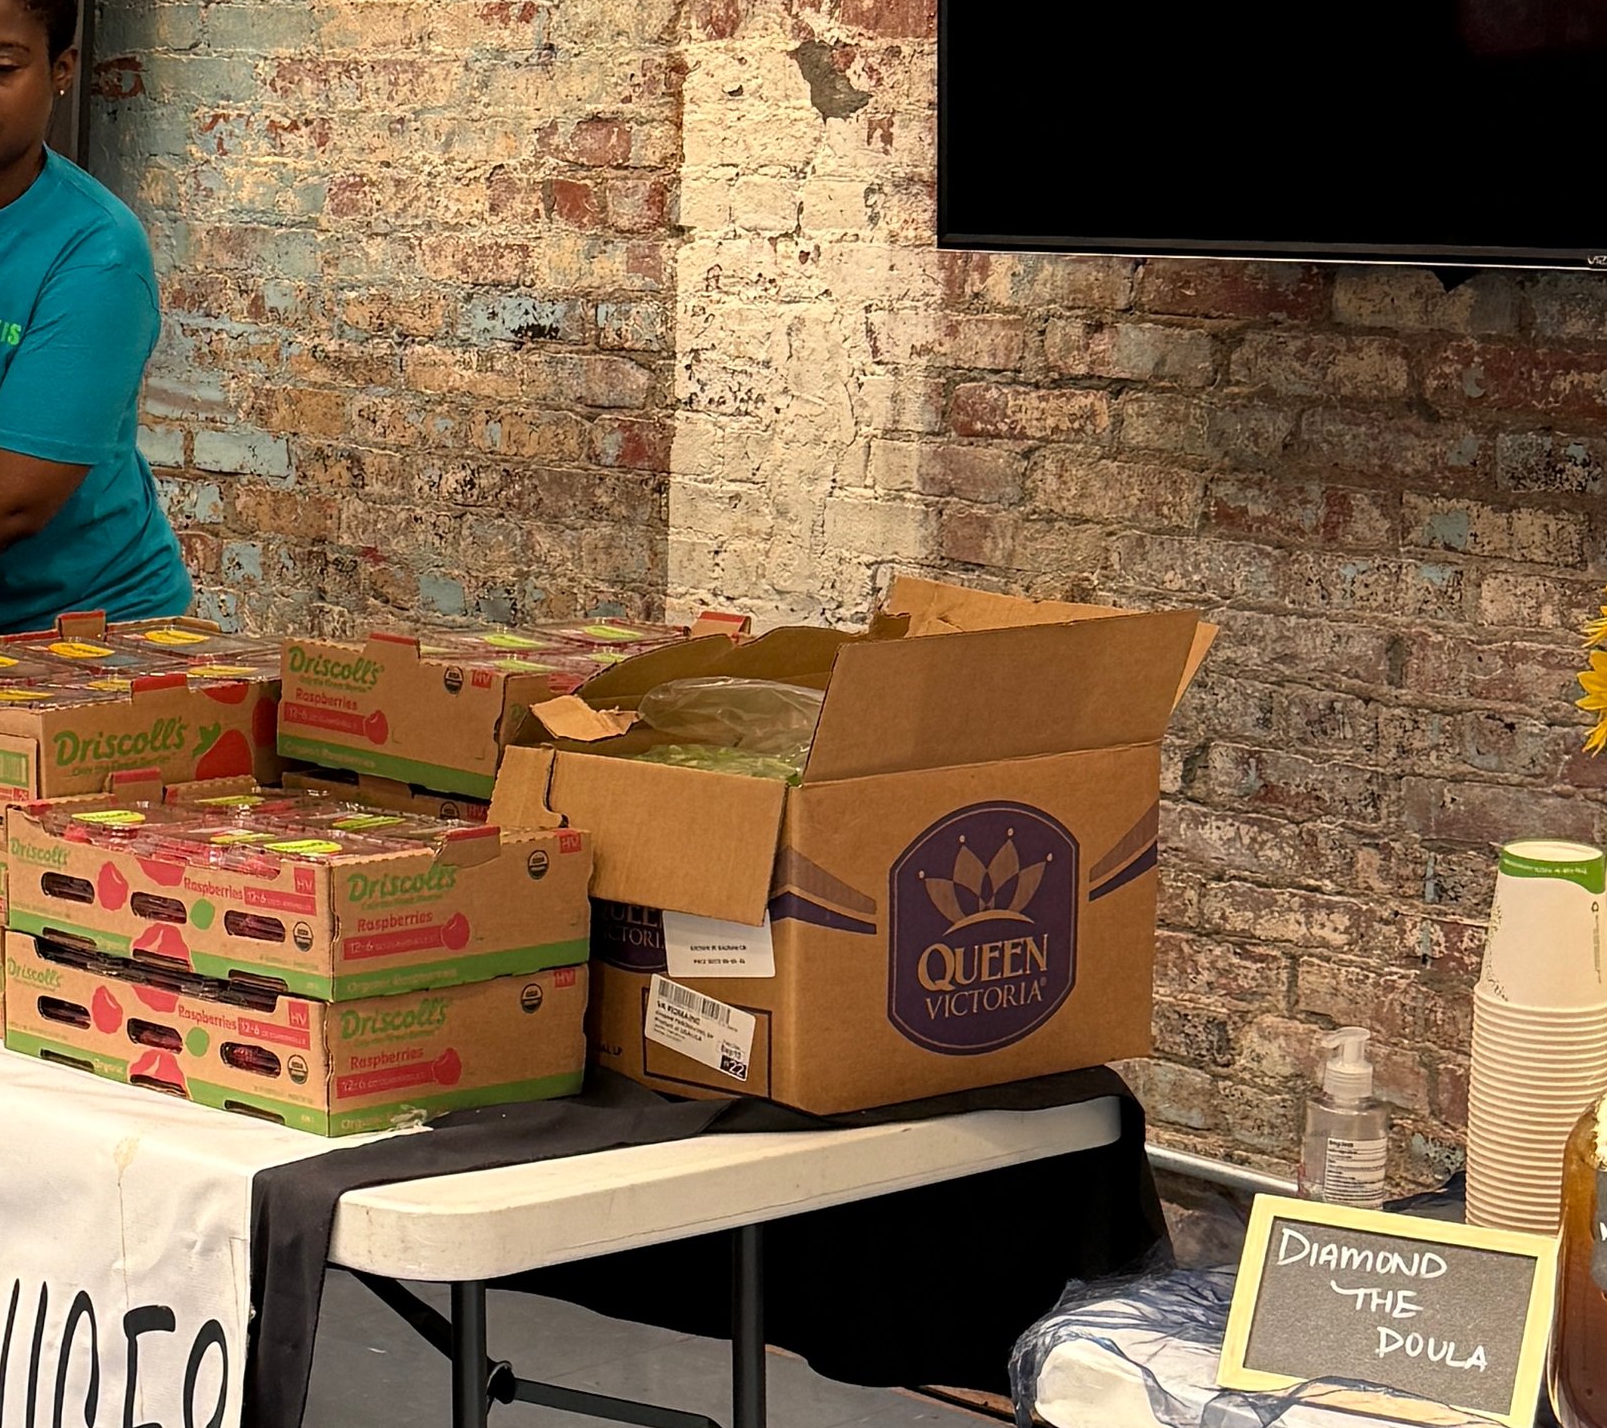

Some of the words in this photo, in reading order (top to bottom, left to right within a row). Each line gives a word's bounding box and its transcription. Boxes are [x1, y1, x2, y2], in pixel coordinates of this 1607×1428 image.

[289, 646, 384, 685] Driscoll's
[296, 687, 358, 711] Raspberries
[53, 716, 190, 767] Driscoll's
[183, 875, 244, 901] Raspberries
[296, 878, 314, 890] HV
[347, 862, 458, 902] Driscoll's
[357, 910, 434, 933] Raspberries
[602, 904, 662, 928] UEE
[604, 923, 664, 950] ICTORI
[917, 933, 1049, 992] QUEEN
[925, 978, 1044, 1021] VICTORIA
[178, 1004, 237, 1031] Raspberries
[290, 1011, 308, 1025] HV
[340, 999, 450, 1040] Driscoll's
[350, 1047, 425, 1071] Raspberries
[1276, 1227, 1448, 1279] DIAMOND
[1330, 1280, 1424, 1318] THE
[1375, 1326, 1488, 1372] DOULA
